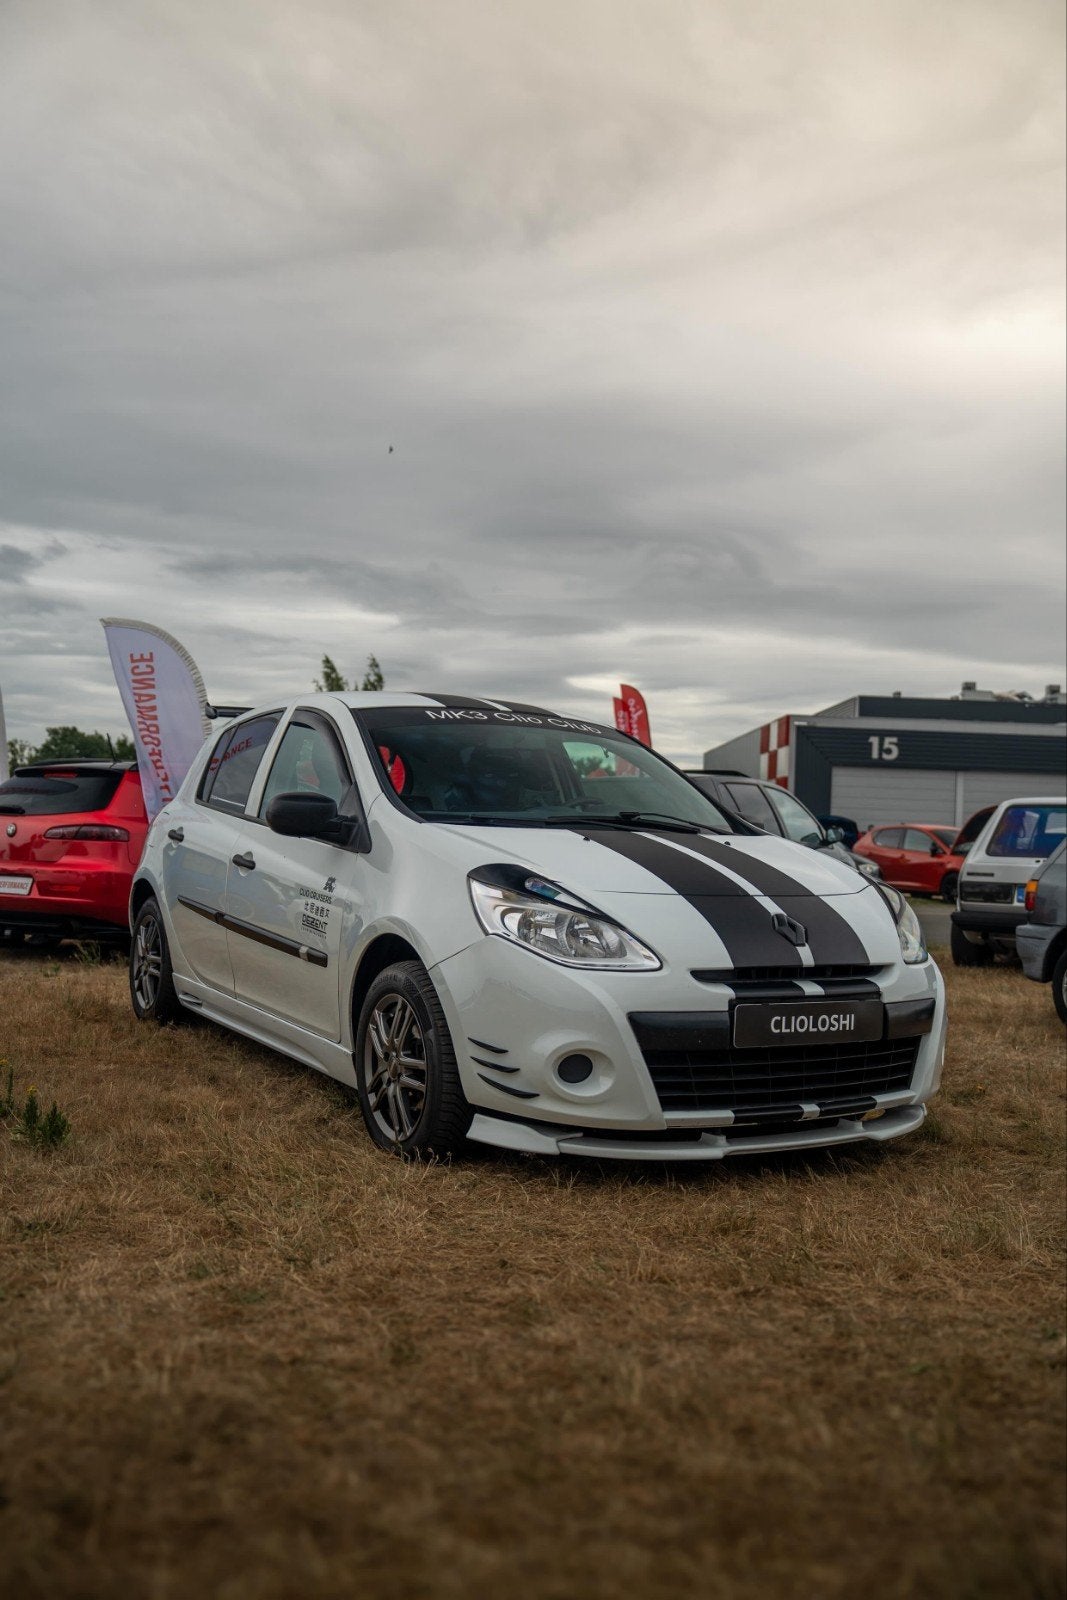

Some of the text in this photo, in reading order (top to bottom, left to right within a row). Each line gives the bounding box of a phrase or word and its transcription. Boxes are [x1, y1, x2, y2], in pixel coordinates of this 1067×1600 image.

[425, 709, 602, 734] MK3 Clio Club
[868, 735, 899, 760] 15
[770, 1013, 855, 1033] CLIOLOSHI
